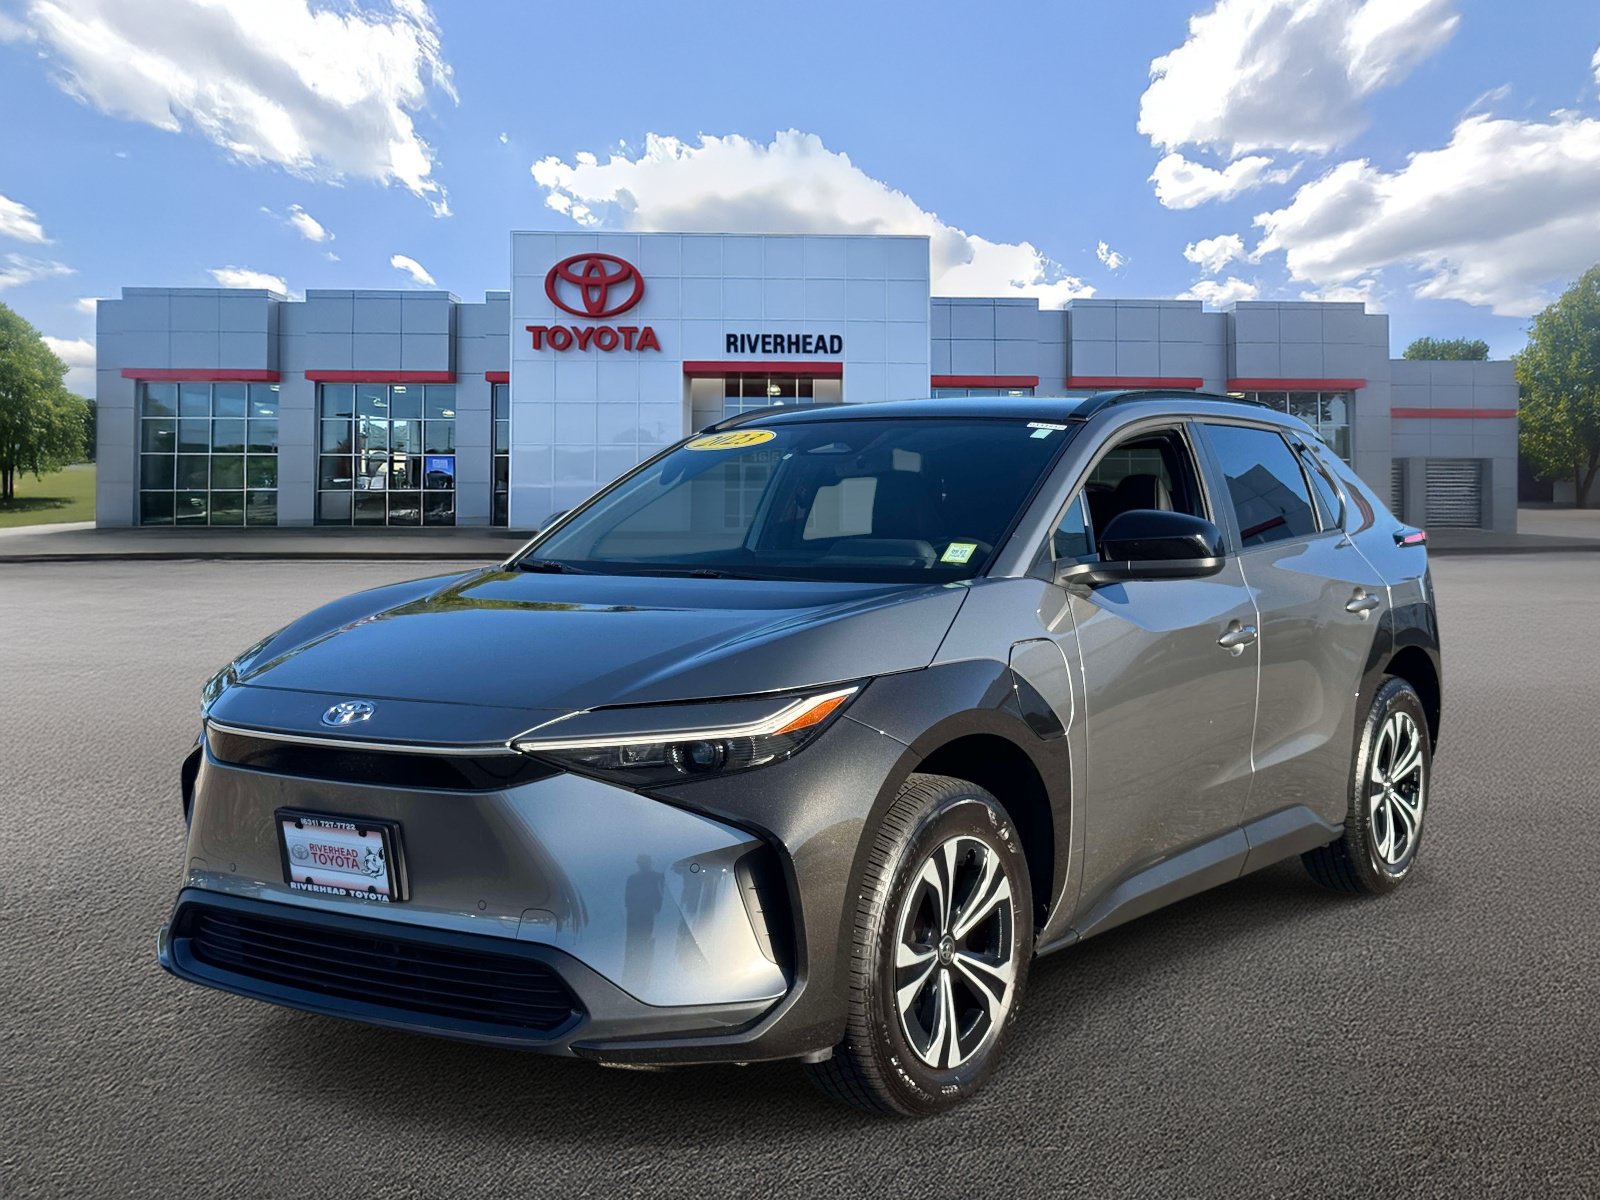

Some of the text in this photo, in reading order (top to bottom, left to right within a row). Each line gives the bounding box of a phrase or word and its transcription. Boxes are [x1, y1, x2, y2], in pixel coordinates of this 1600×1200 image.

[526, 326, 661, 352] TOYOTA
[726, 334, 844, 354] RIVERHEAD
[308, 843, 358, 858] RIVERHEAD
[311, 852, 360, 870] TOYOTA
[290, 881, 390, 902] RIVERHEAD TOYOTA
